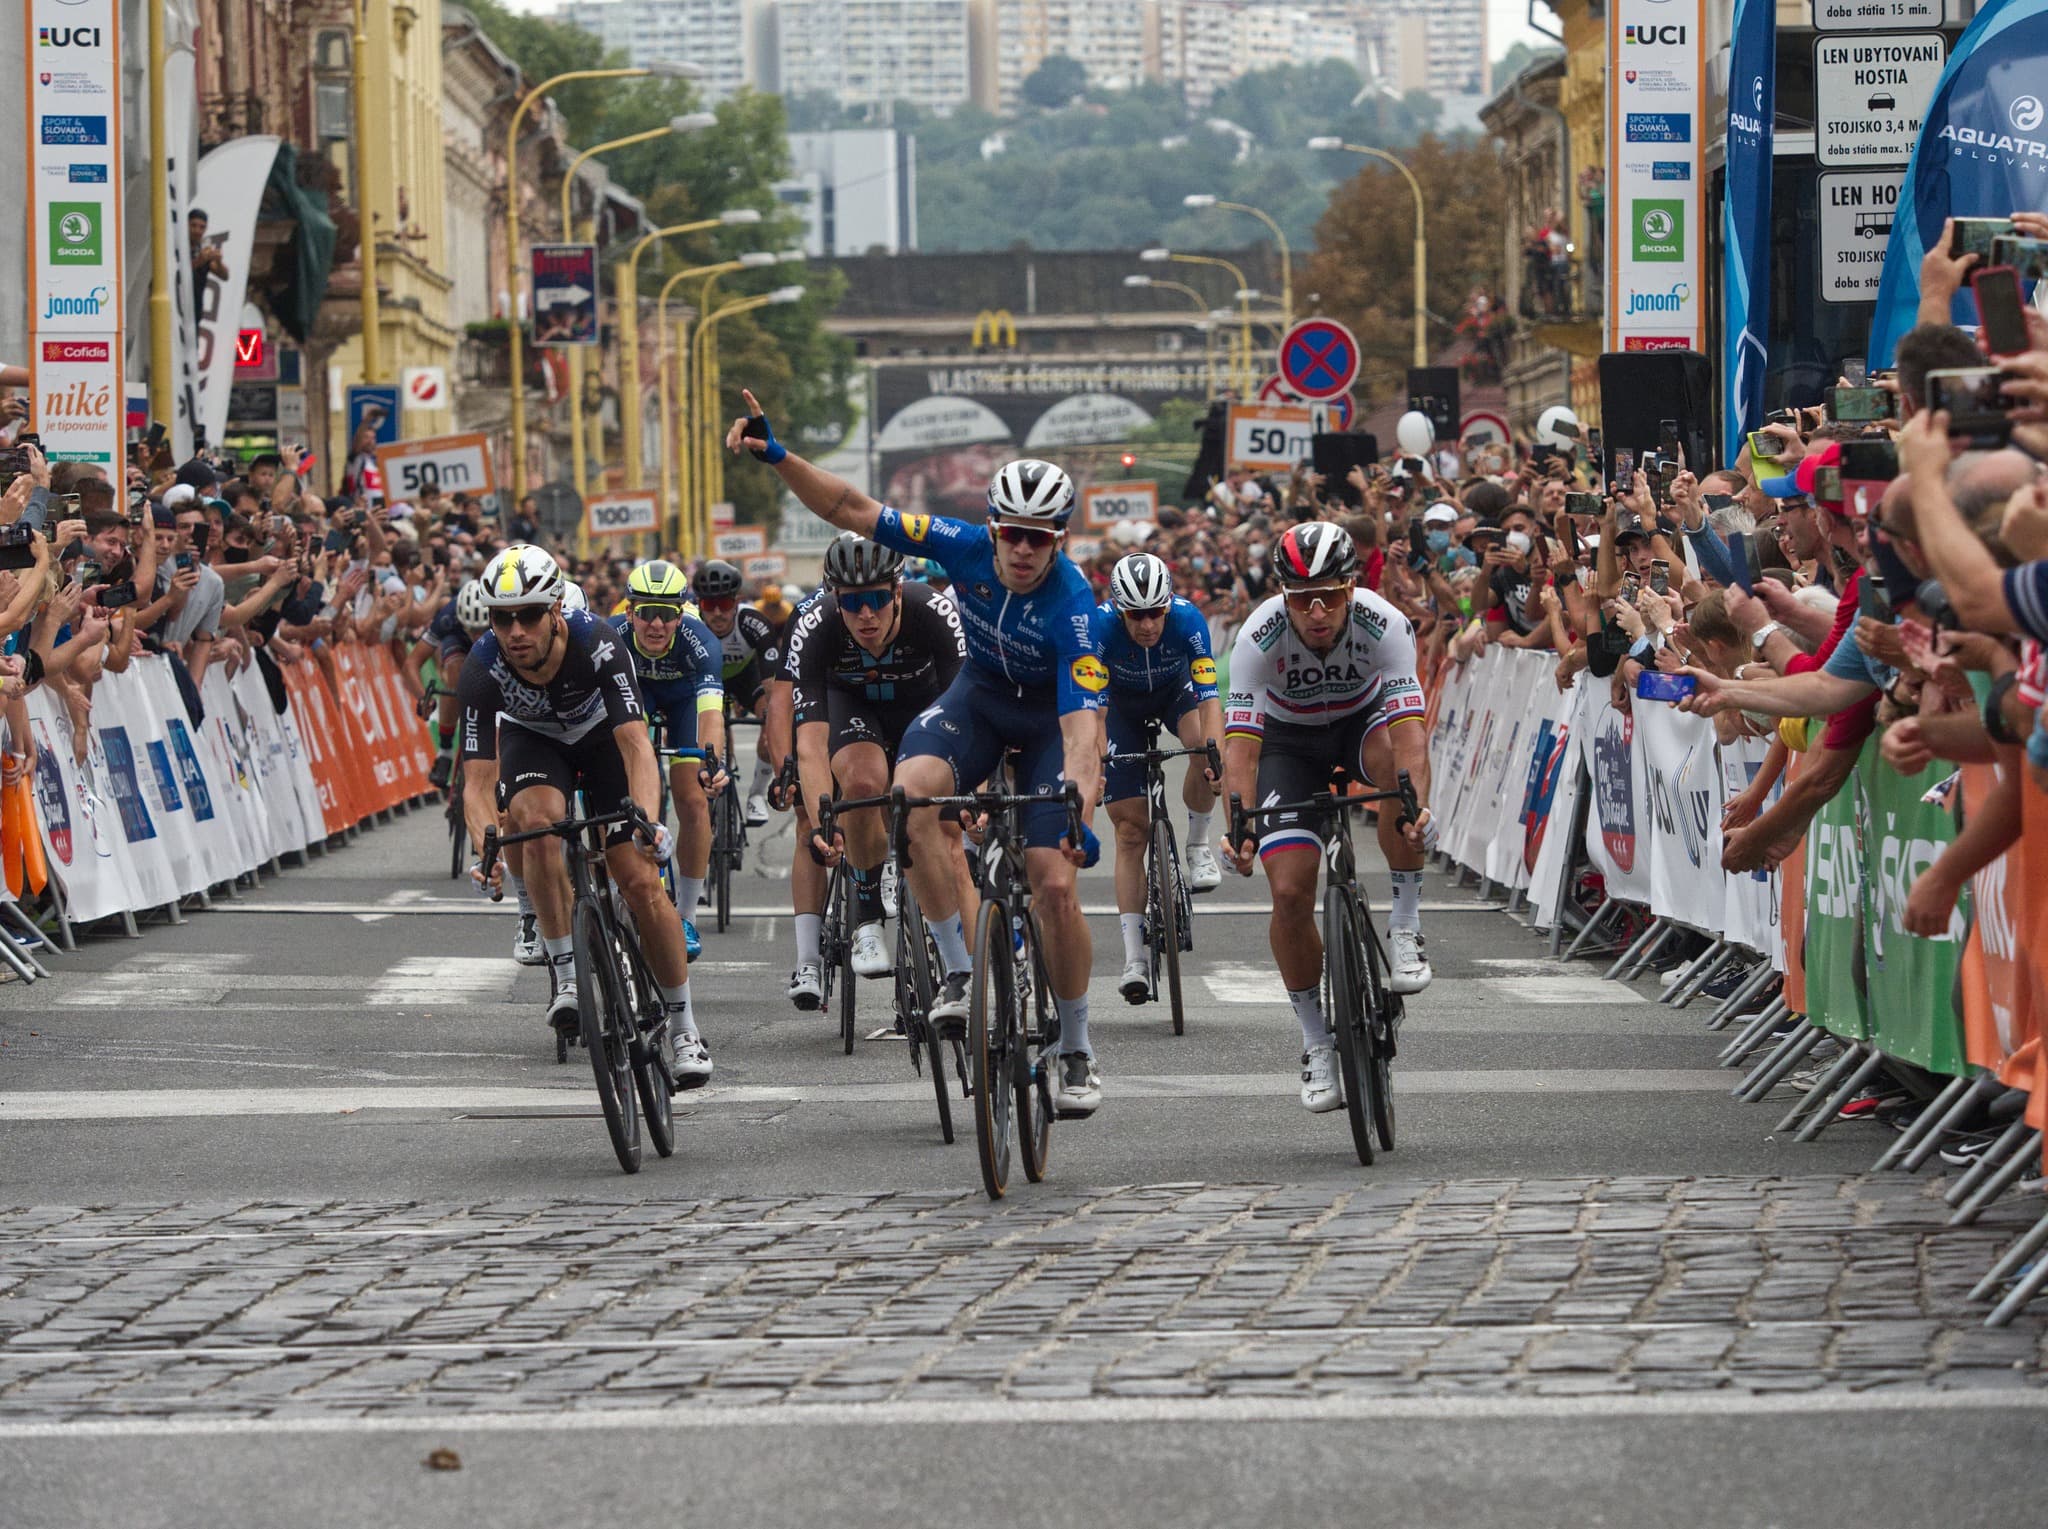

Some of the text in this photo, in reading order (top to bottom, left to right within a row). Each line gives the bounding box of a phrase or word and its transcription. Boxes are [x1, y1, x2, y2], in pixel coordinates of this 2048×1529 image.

[1826, 3, 1932, 17] doba státia 15 min.
[51, 27, 100, 48] UCI
[1637, 25, 1686, 46] UCI
[1823, 42, 1938, 64] LEN UBYTOVANÍ
[1855, 68, 1908, 85] HOSTIA
[44, 117, 73, 126] SPORT
[1629, 115, 1657, 124] SPORT
[44, 126, 87, 135] SLOVAKIA
[1629, 124, 1671, 132] SLOVAKIA
[1828, 120, 1882, 134] STOJISKO
[1886, 120, 1904, 134] 3,4
[1828, 144, 1850, 155] doba
[1853, 143, 1878, 154] státia
[1880, 144, 1903, 154] max.
[1938, 124, 2048, 160] AQUATR
[1831, 184, 1903, 206] LEN HO
[57, 247, 95, 256] ŠKODA
[1640, 244, 1677, 253] ŠKODA
[1837, 250, 1887, 263] STOJISKO
[1834, 275, 1880, 288] doba stá
[64, 346, 107, 358] Cofidis
[45, 381, 110, 417] niké
[44, 420, 109, 433] je tipovanie
[56, 452, 99, 463] hansgrohe
[1354, 602, 1388, 632] BORA
[926, 592, 968, 658] zoover
[1251, 610, 1284, 644] BORA
[1285, 663, 1365, 690] BORA
[612, 672, 641, 715] BMC
[464, 705, 479, 753] BMC
